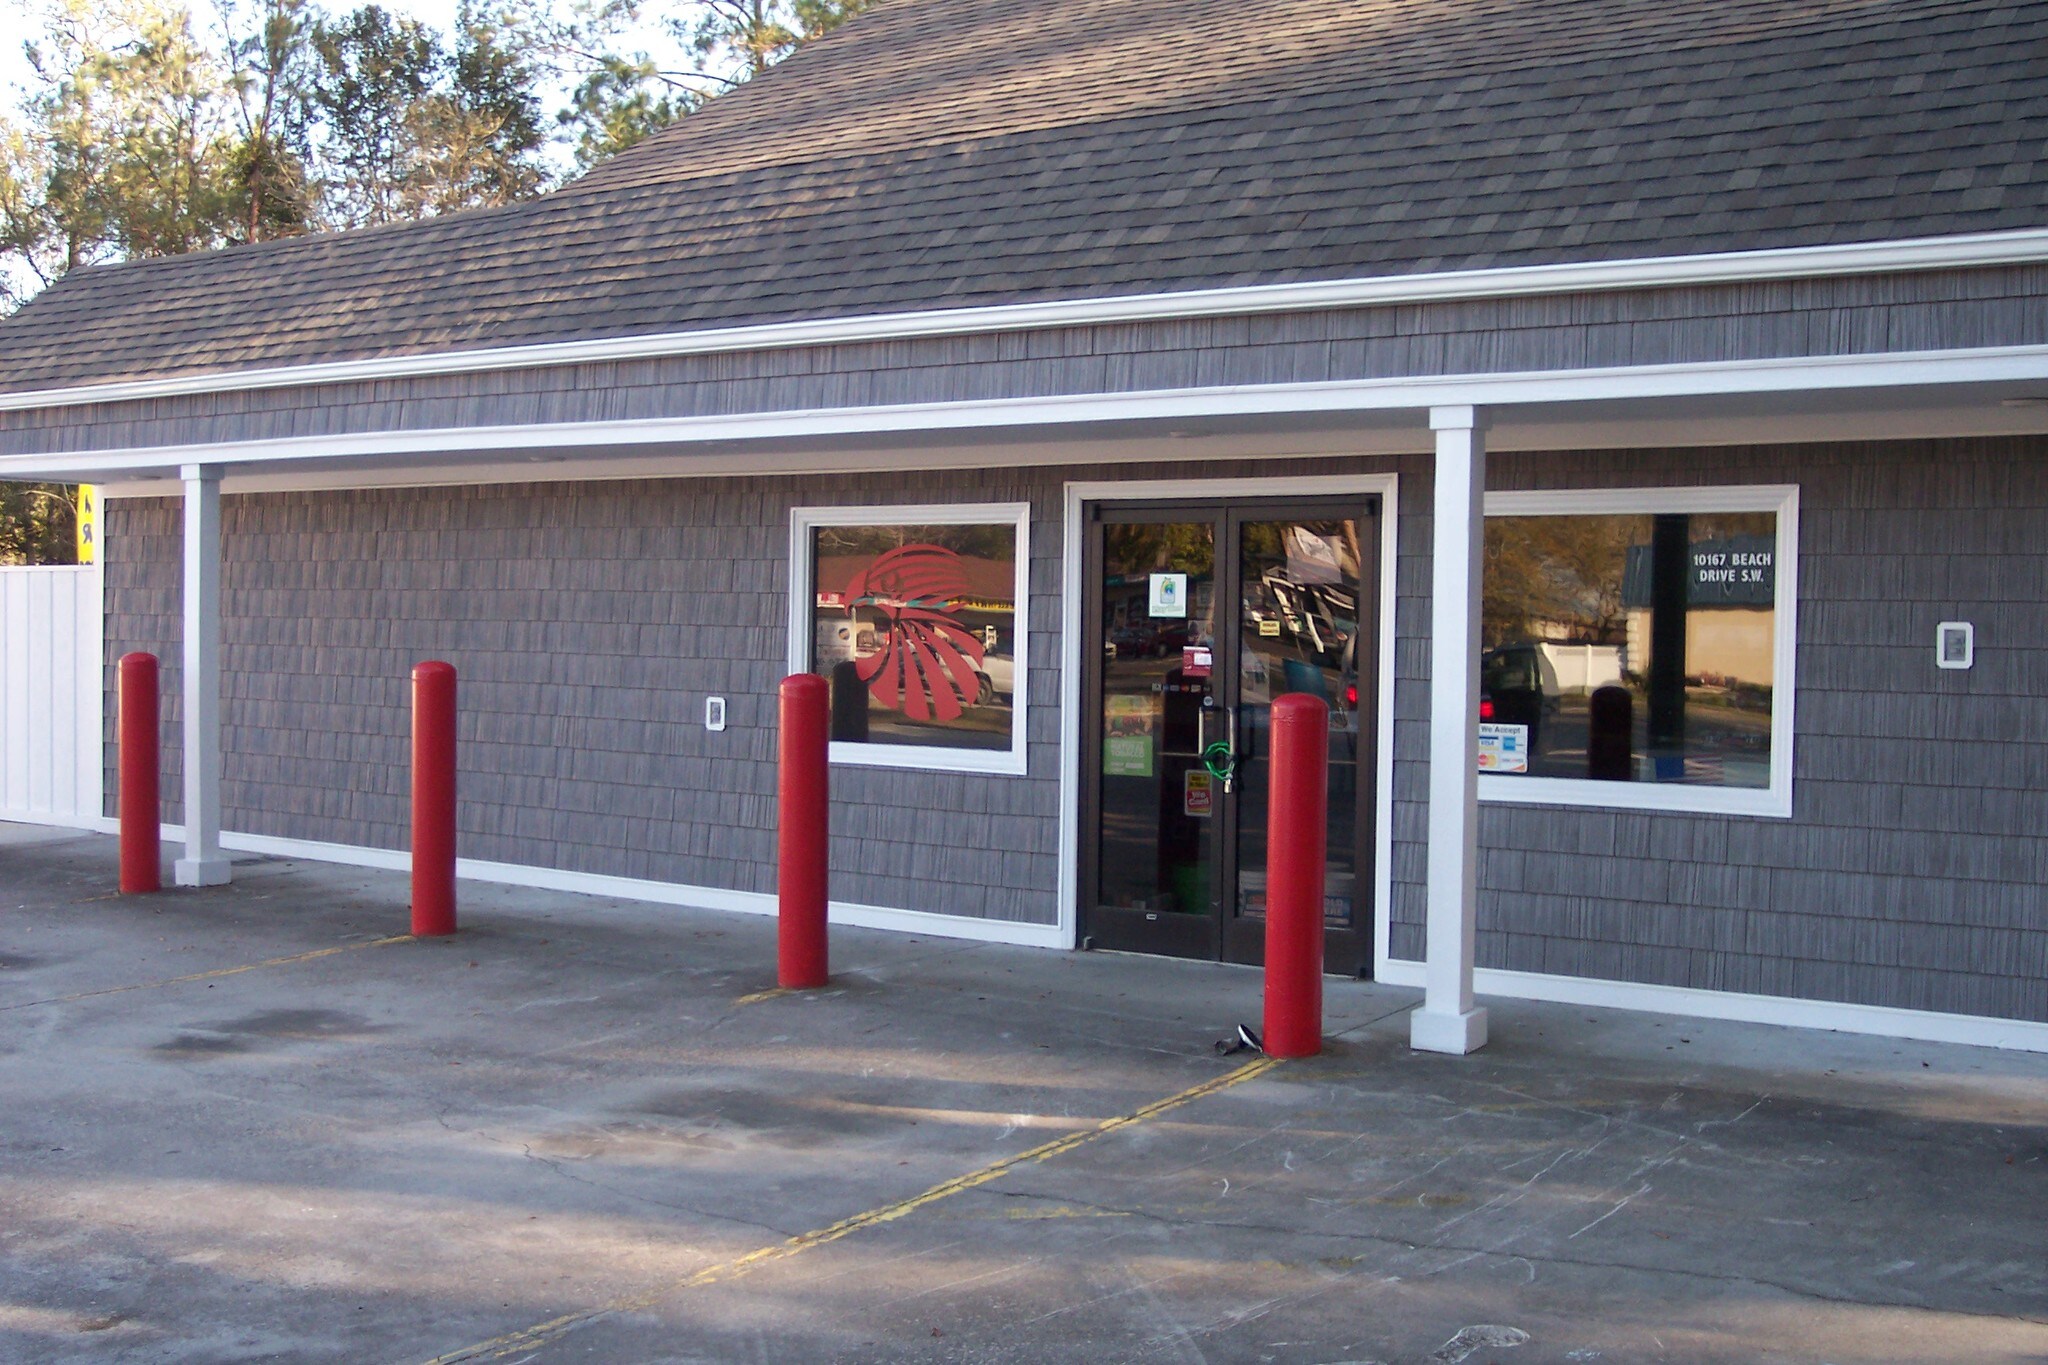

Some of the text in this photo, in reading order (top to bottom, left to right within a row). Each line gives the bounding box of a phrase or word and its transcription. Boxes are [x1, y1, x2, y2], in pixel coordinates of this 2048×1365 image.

[1693, 552, 1771, 566] 10167 BEACH
[1700, 569, 1764, 582] DRIVE S.W.
[1481, 725, 1521, 735] We Accept
